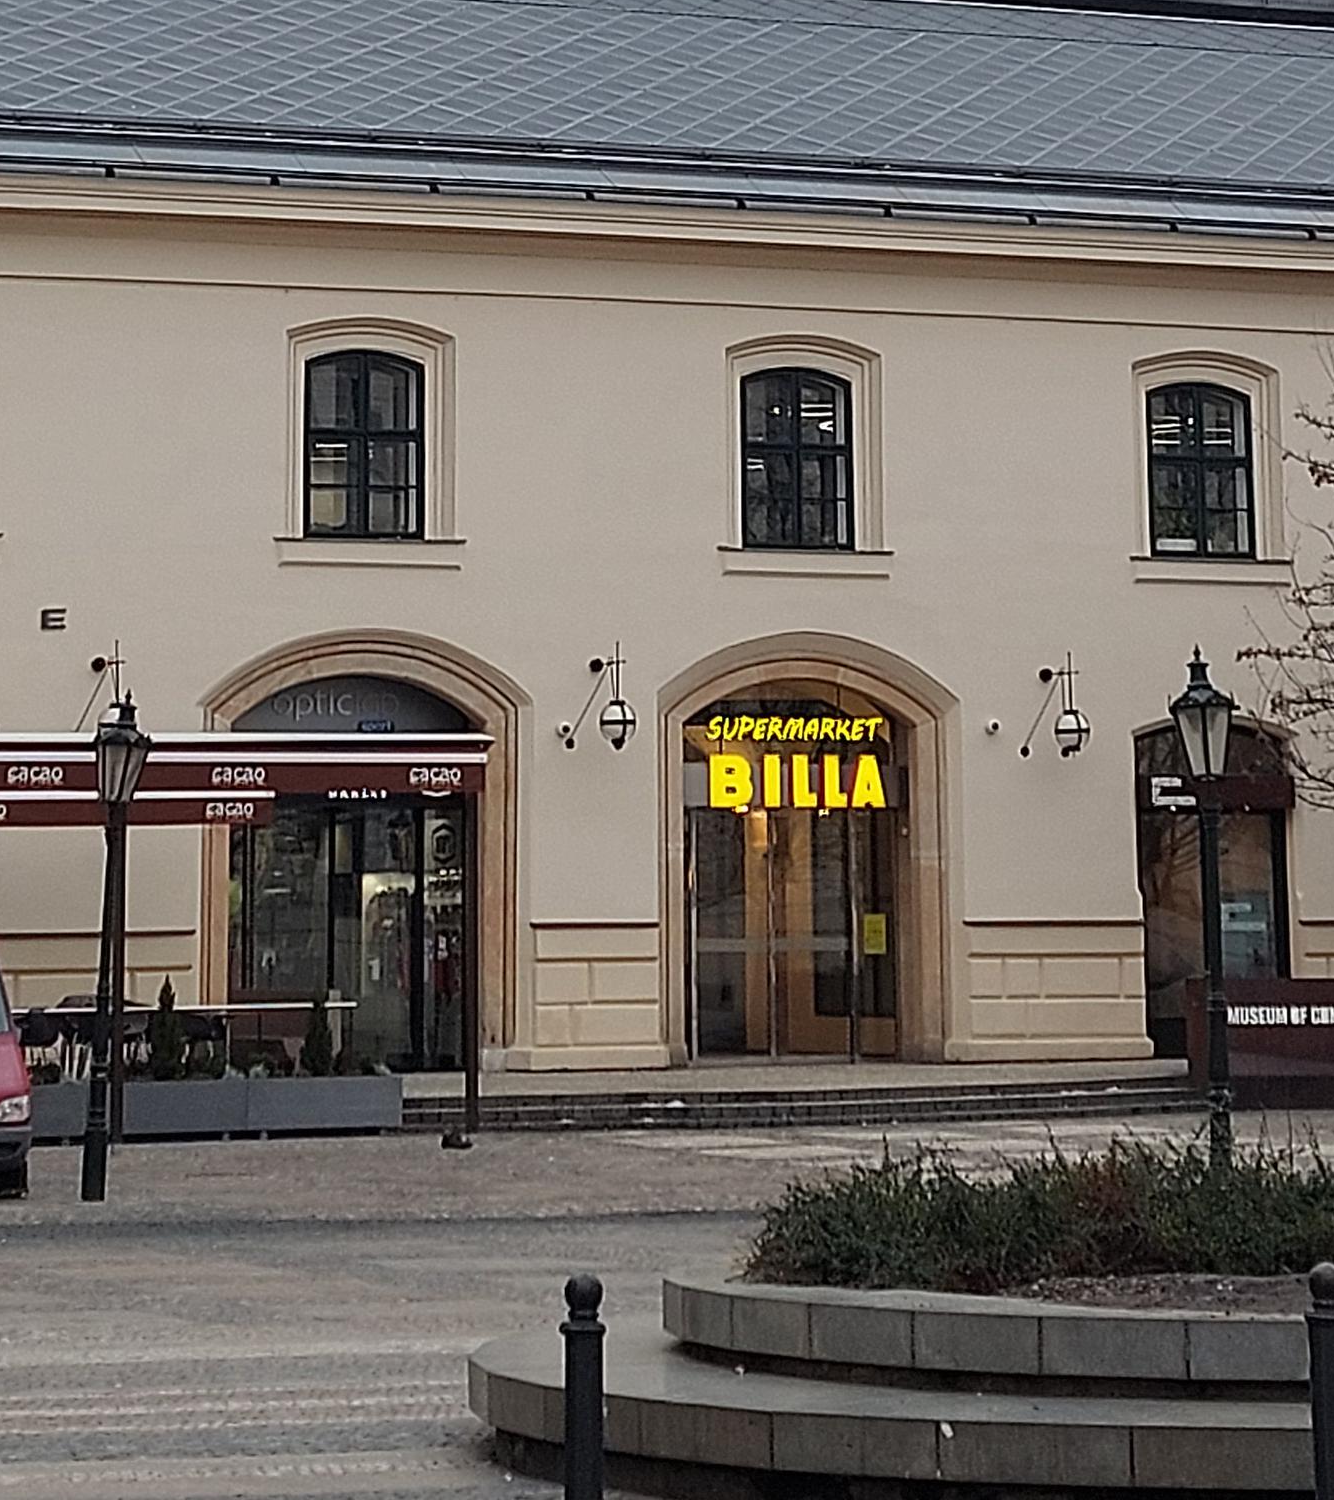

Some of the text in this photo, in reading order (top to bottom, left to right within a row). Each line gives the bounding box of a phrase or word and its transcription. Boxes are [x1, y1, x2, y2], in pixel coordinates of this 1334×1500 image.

[706, 715, 883, 741] SUPERMARKET
[7, 765, 63, 781] cacao
[212, 766, 265, 782] cacao
[409, 767, 461, 782] cacao
[710, 754, 886, 808] BILLA
[206, 802, 254, 817] cacao
[1227, 1005, 1288, 1025] MUSEUM
[1290, 1006, 1307, 1025] OF
